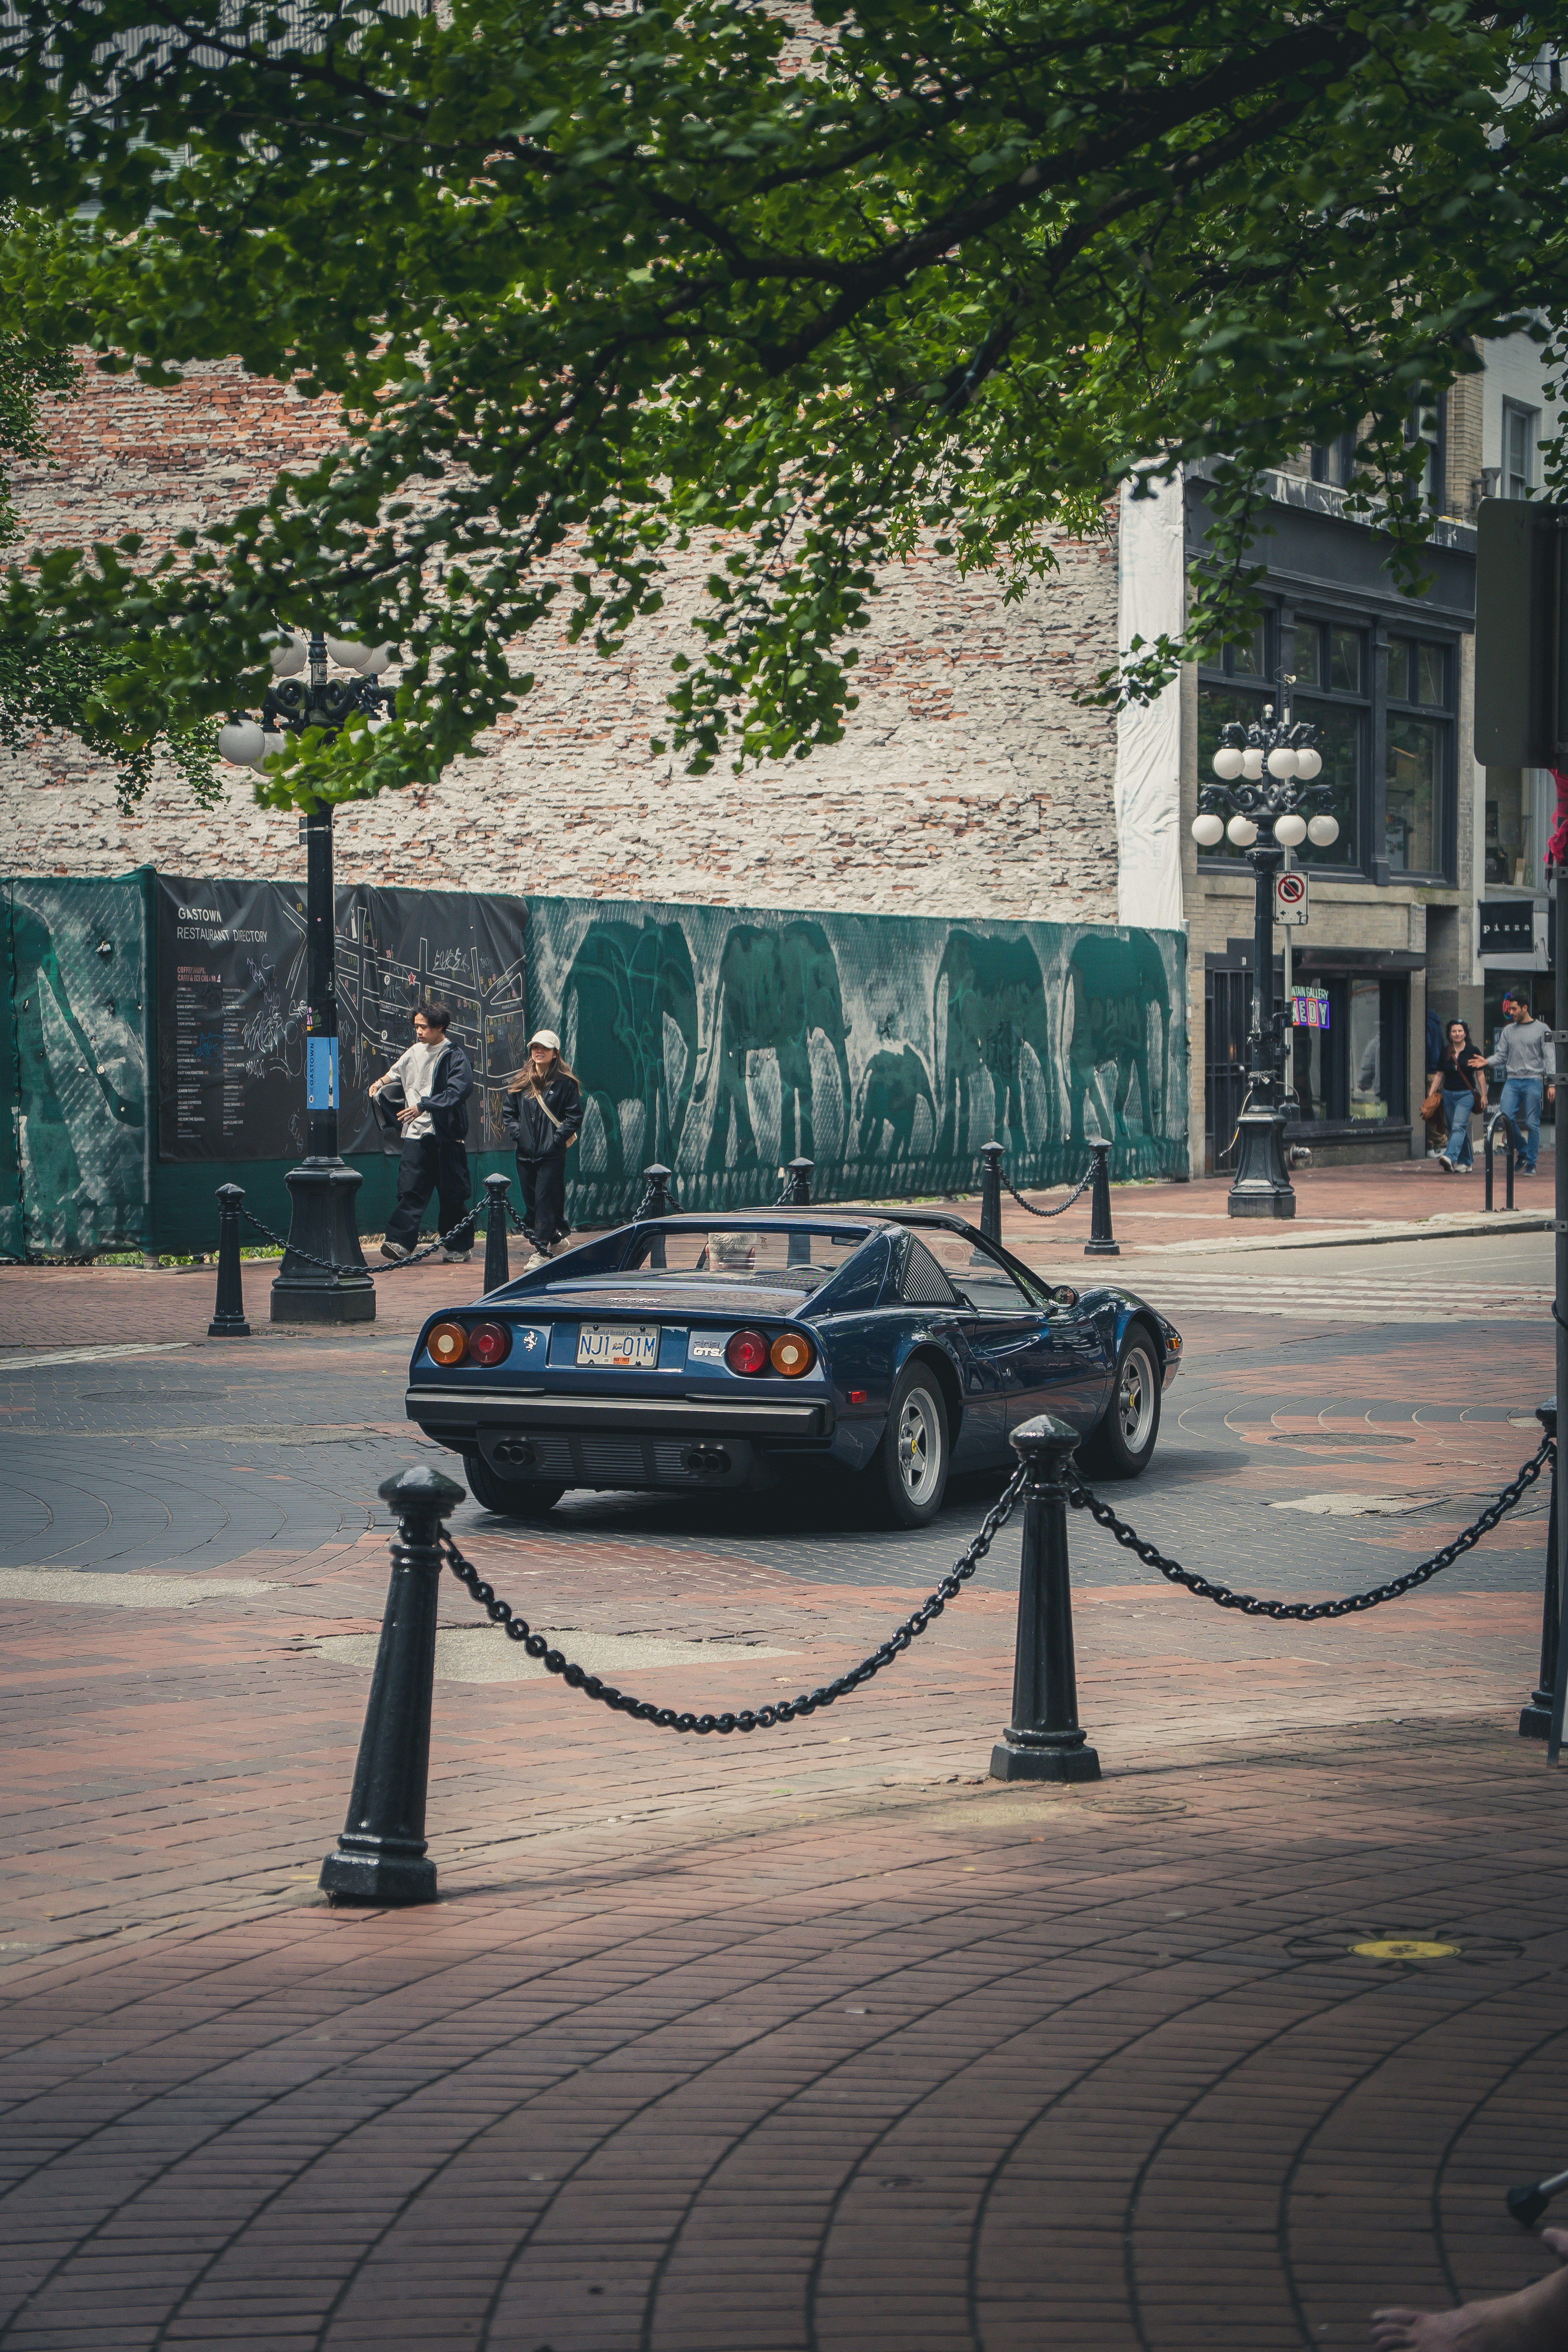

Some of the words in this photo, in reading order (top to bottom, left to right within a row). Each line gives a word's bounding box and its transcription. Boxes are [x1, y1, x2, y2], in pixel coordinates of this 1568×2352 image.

[297, 903, 302, 911] 60
[178, 907, 221, 922] GASTOWN
[177, 927, 229, 941] RESTAURANT
[233, 929, 267, 942] DIRECTORY
[1483, 923, 1530, 934] pizza
[1306, 987, 1328, 1000] GALLERY
[580, 1335, 610, 1355] NJ1
[694, 1339, 720, 1348] 308
